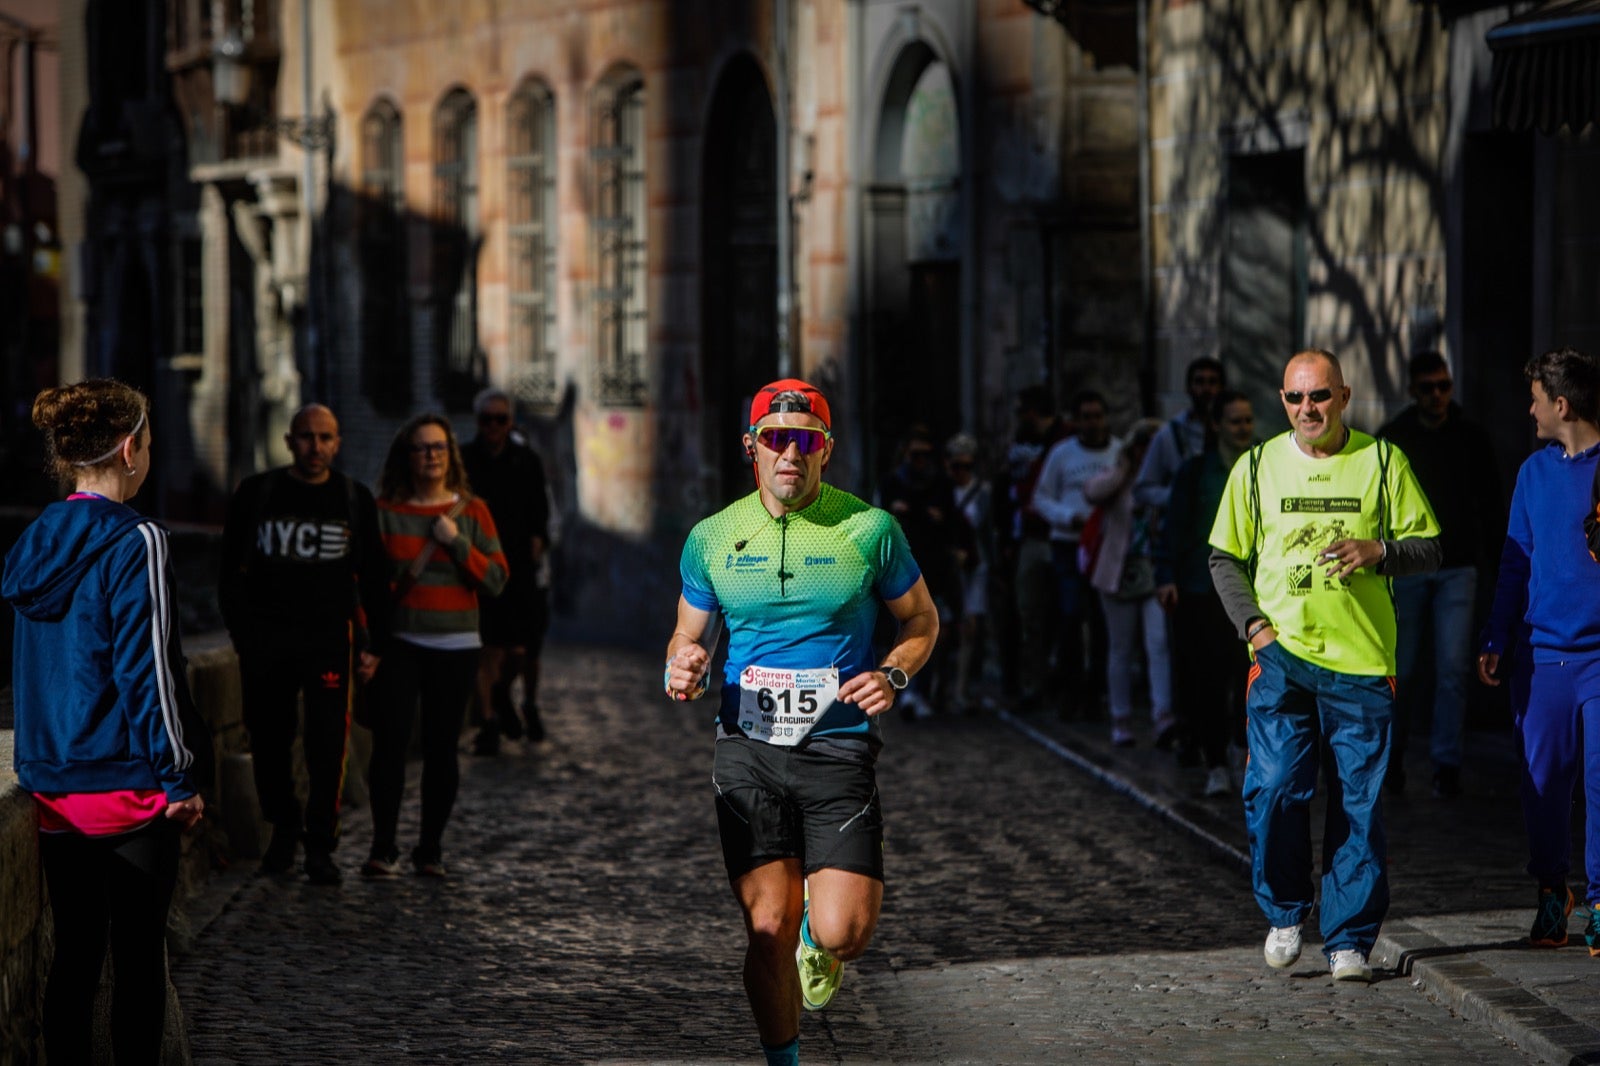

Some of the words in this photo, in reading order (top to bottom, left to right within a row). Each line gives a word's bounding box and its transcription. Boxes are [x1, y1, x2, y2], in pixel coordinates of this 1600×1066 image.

[755, 669, 792, 680] Carrera
[755, 678, 795, 689] Solidaria
[757, 687, 818, 714] 615
